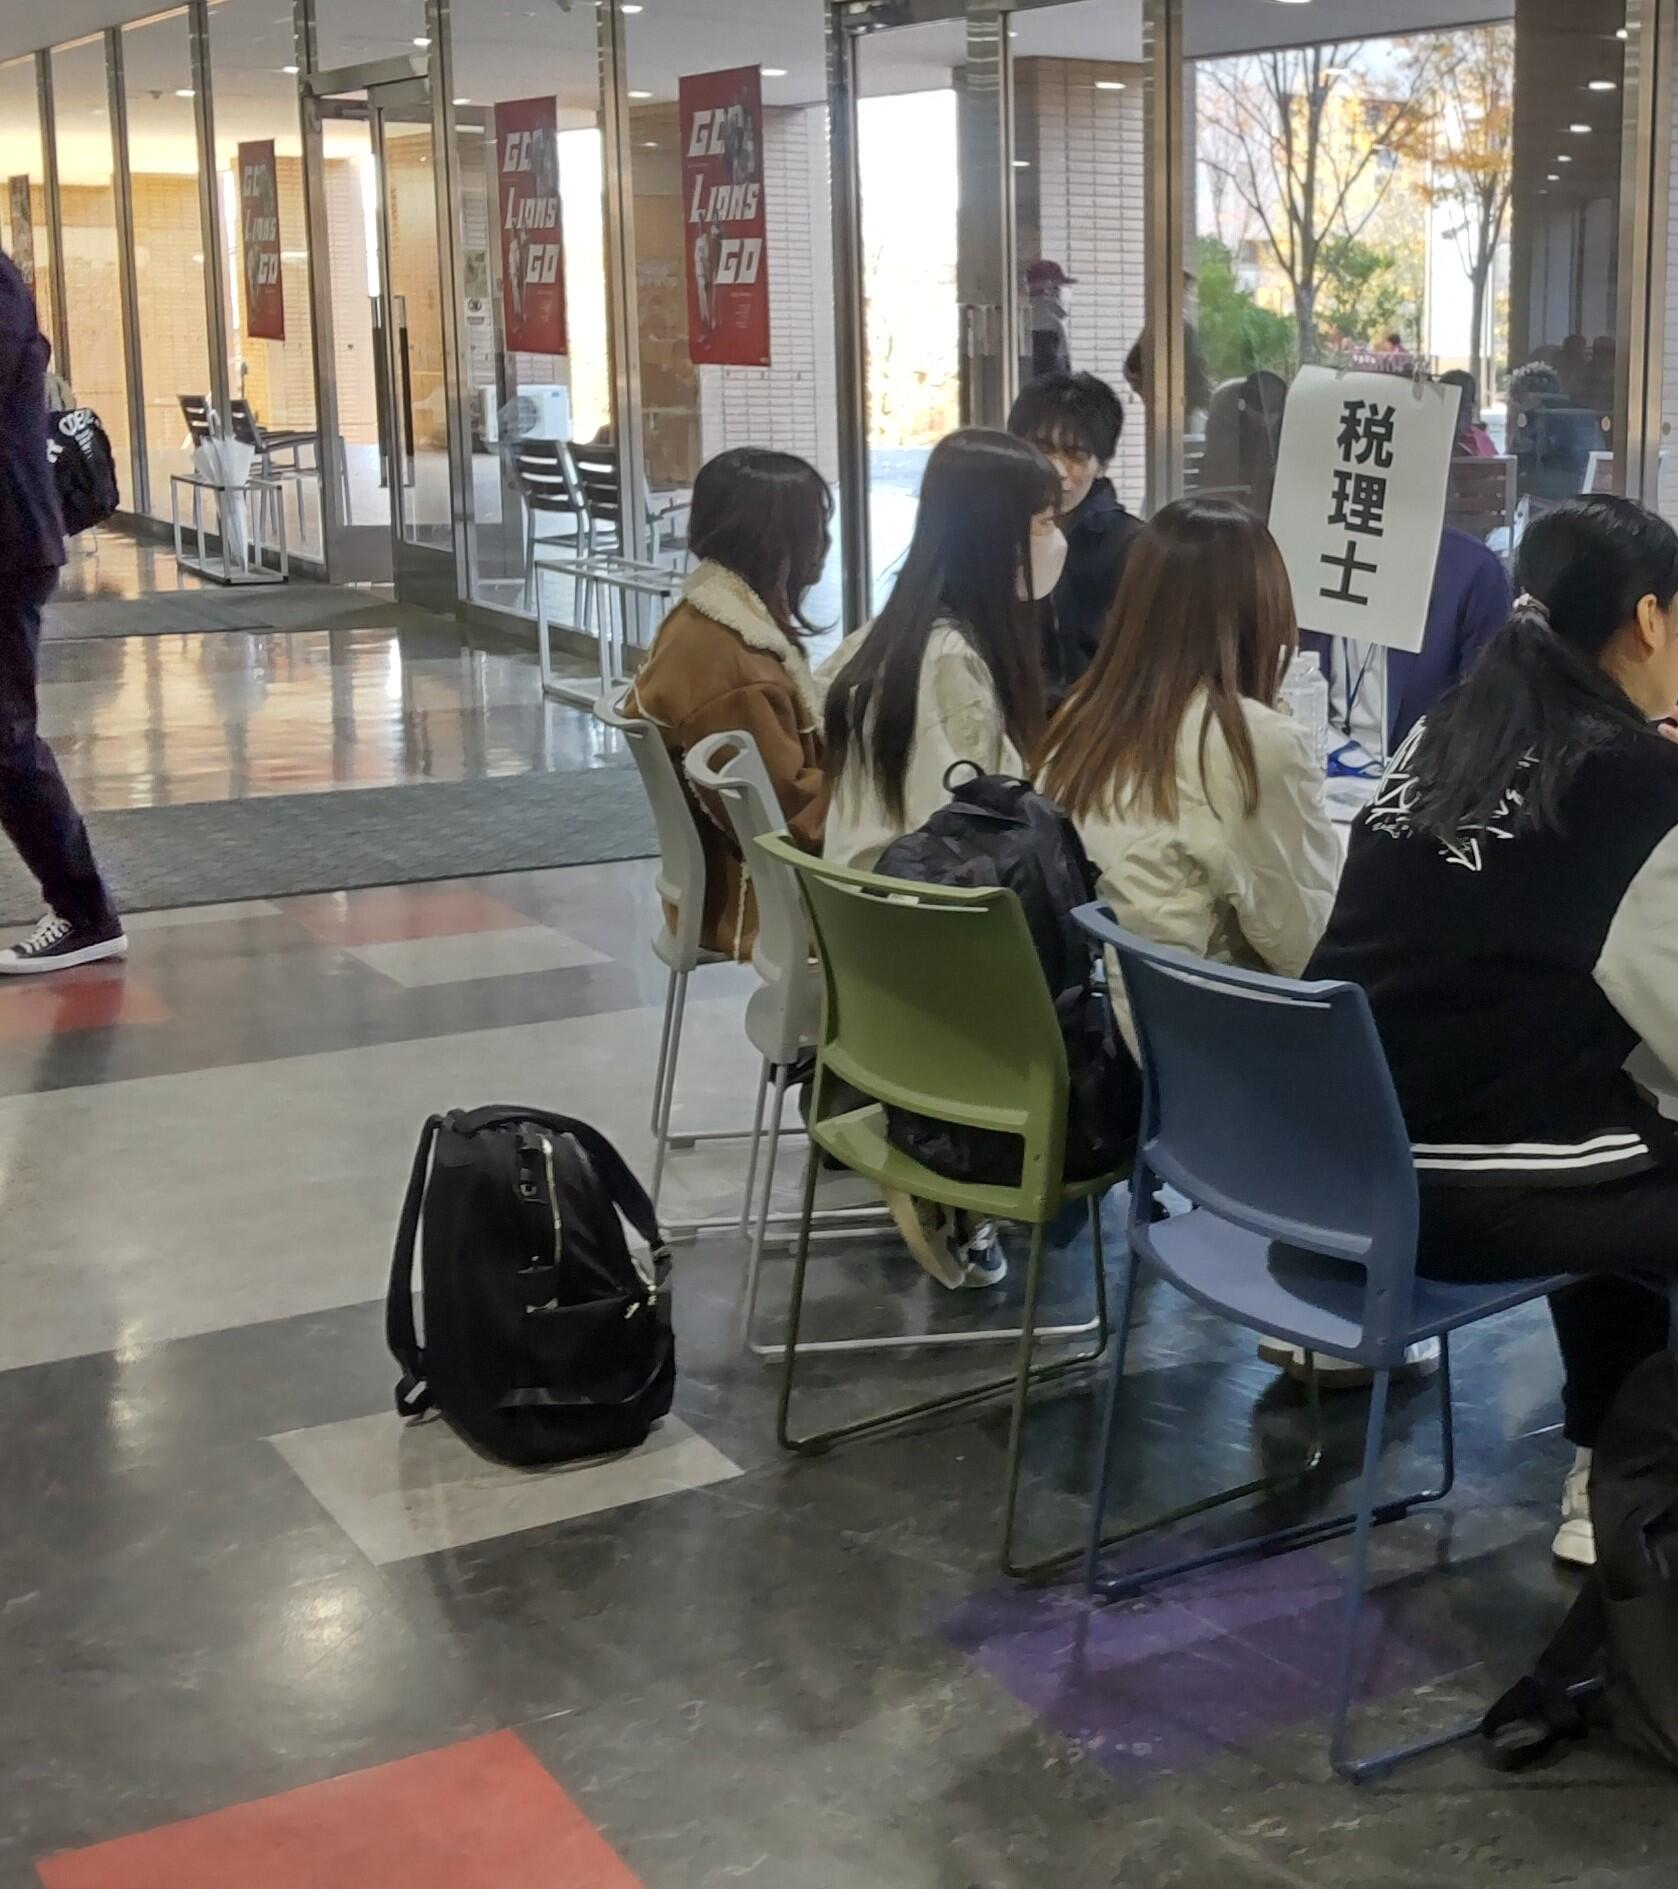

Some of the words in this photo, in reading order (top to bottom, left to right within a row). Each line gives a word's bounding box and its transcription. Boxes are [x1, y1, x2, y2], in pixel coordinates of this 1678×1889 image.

[526, 244, 560, 283] GO
[715, 238, 762, 284] GO
[1319, 399, 1396, 606] 税理士
